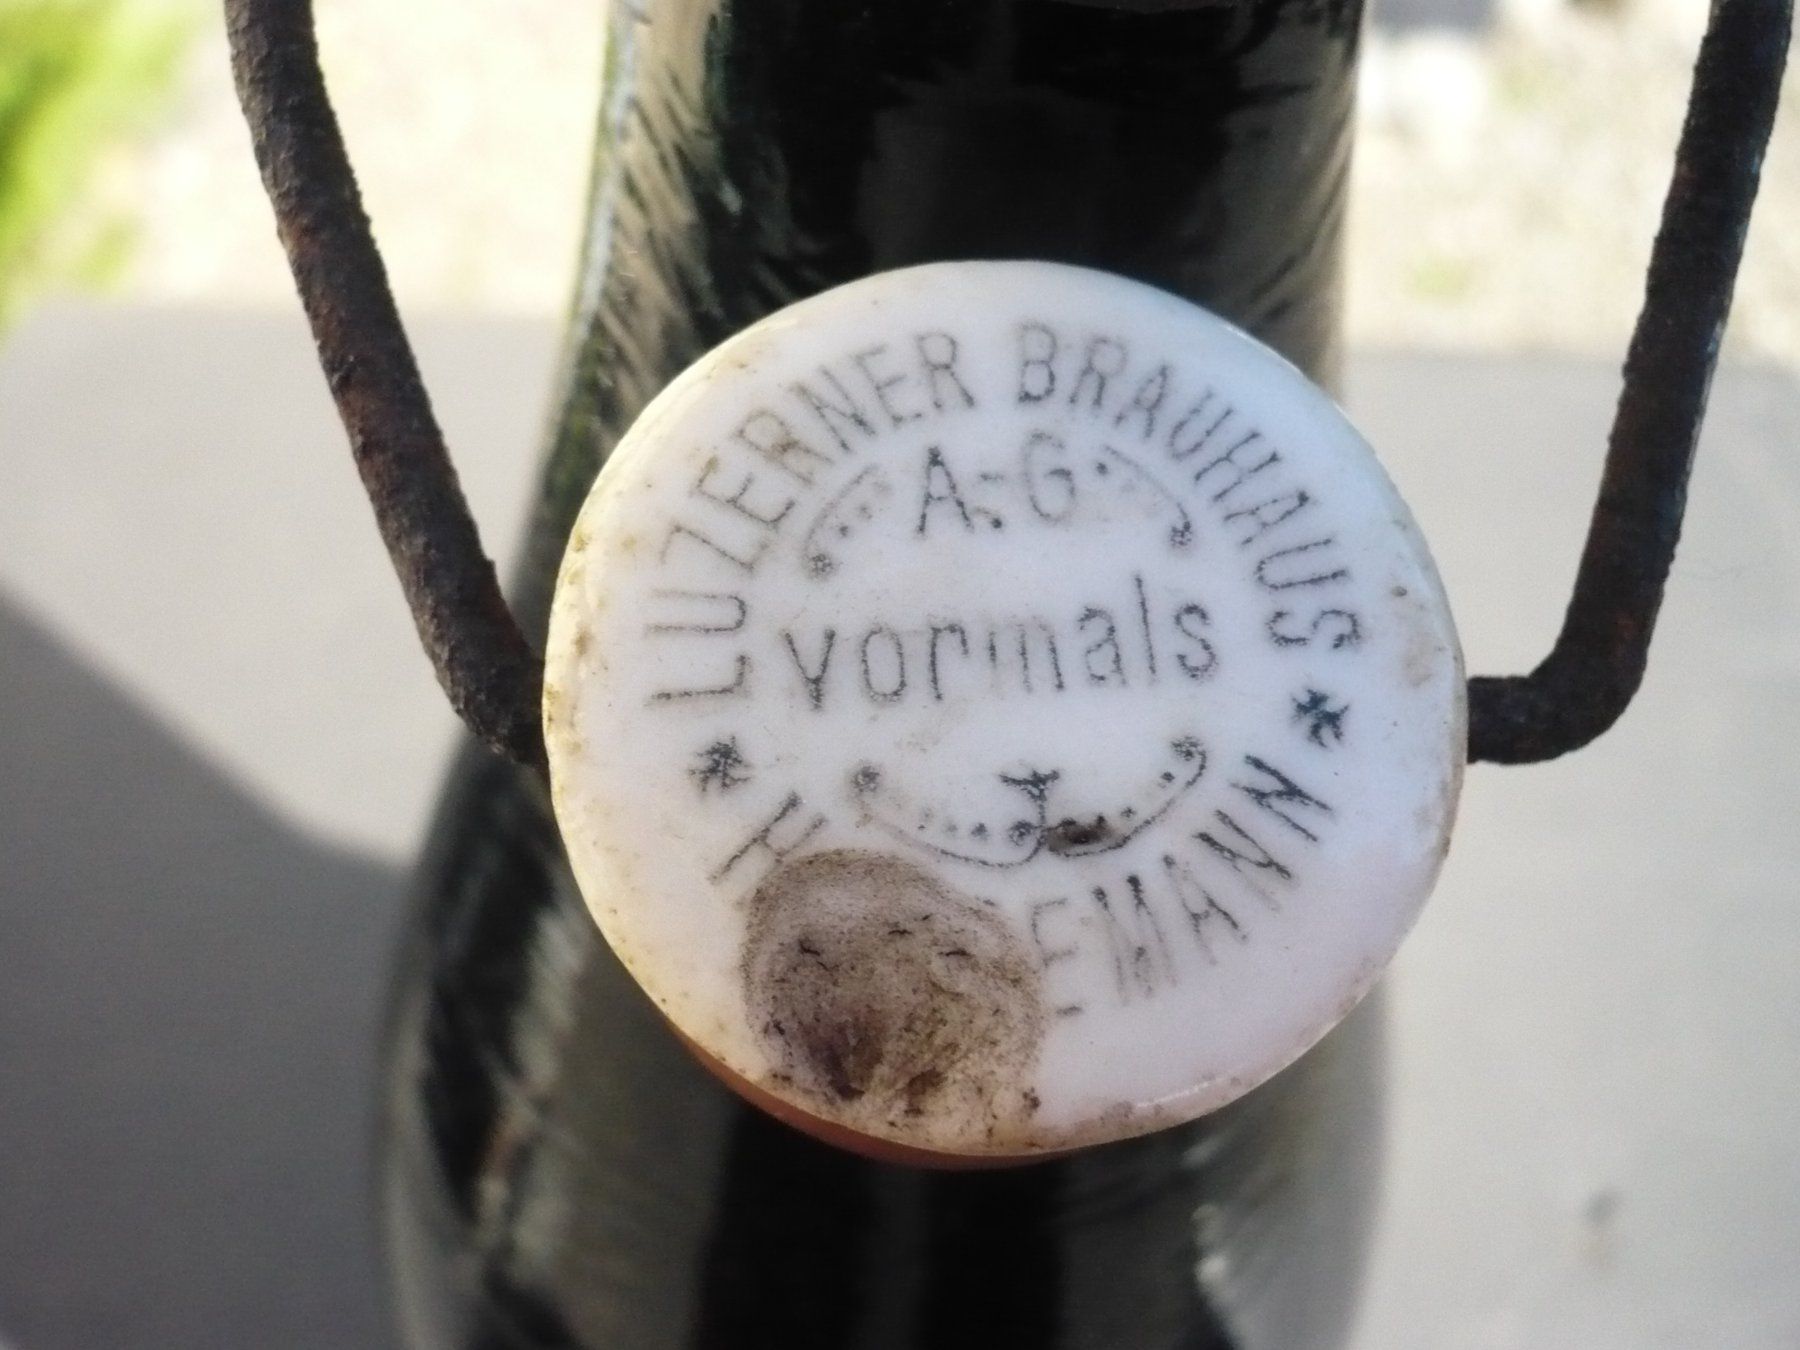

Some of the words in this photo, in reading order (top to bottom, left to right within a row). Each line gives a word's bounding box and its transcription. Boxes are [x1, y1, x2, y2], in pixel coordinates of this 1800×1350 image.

[646, 332, 975, 707] LUZERNER
[1016, 320, 1363, 650] BRAUHAUS
[778, 572, 1217, 711] vormals
